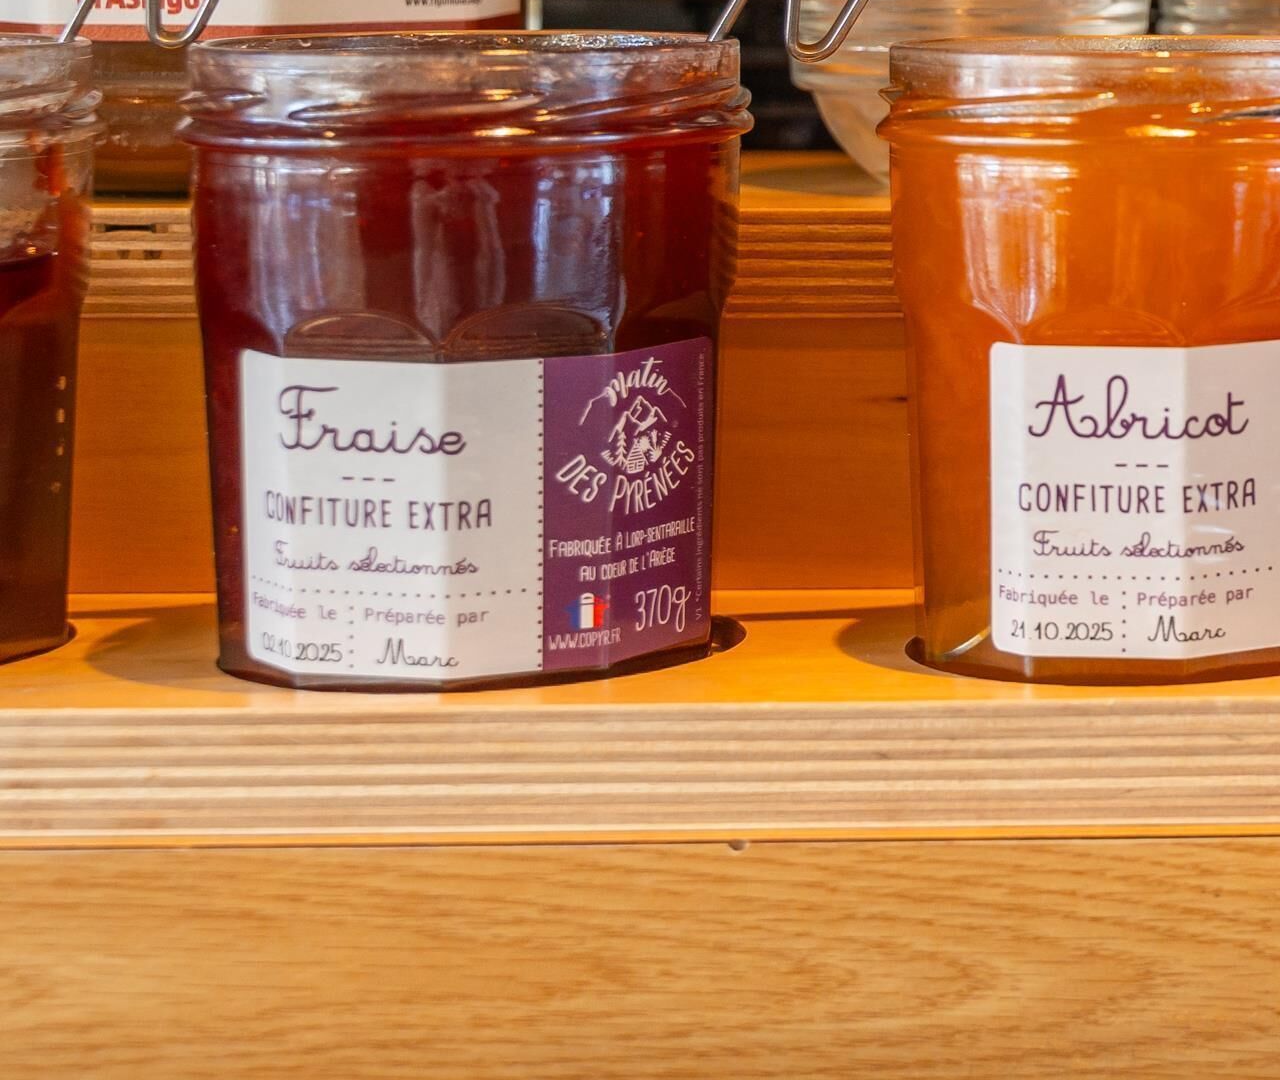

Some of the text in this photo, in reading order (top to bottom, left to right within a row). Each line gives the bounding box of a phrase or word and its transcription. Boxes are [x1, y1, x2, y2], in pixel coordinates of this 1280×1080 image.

[606, 356, 670, 407] Matin
[277, 385, 468, 456] Fraise
[1028, 373, 1250, 440] Abricot
[556, 440, 695, 515] DES PYRÉNÉES
[265, 490, 493, 532] CONFITURE EXTRA
[1018, 477, 1256, 514] CONFITURE EXTRA
[274, 539, 480, 575] Fruits sélectionnés
[1032, 529, 1245, 558] Fruits sélectionnés
[251, 591, 337, 620] Fabriquée le
[634, 584, 692, 633] 370g
[998, 584, 1110, 609] Fabriquée le
[1137, 586, 1255, 610] Préparée par
[364, 607, 490, 627] Préparée par
[1010, 619, 1114, 641] 21.10.2025
[1147, 615, 1226, 643] Marc
[376, 637, 460, 668] Marc
